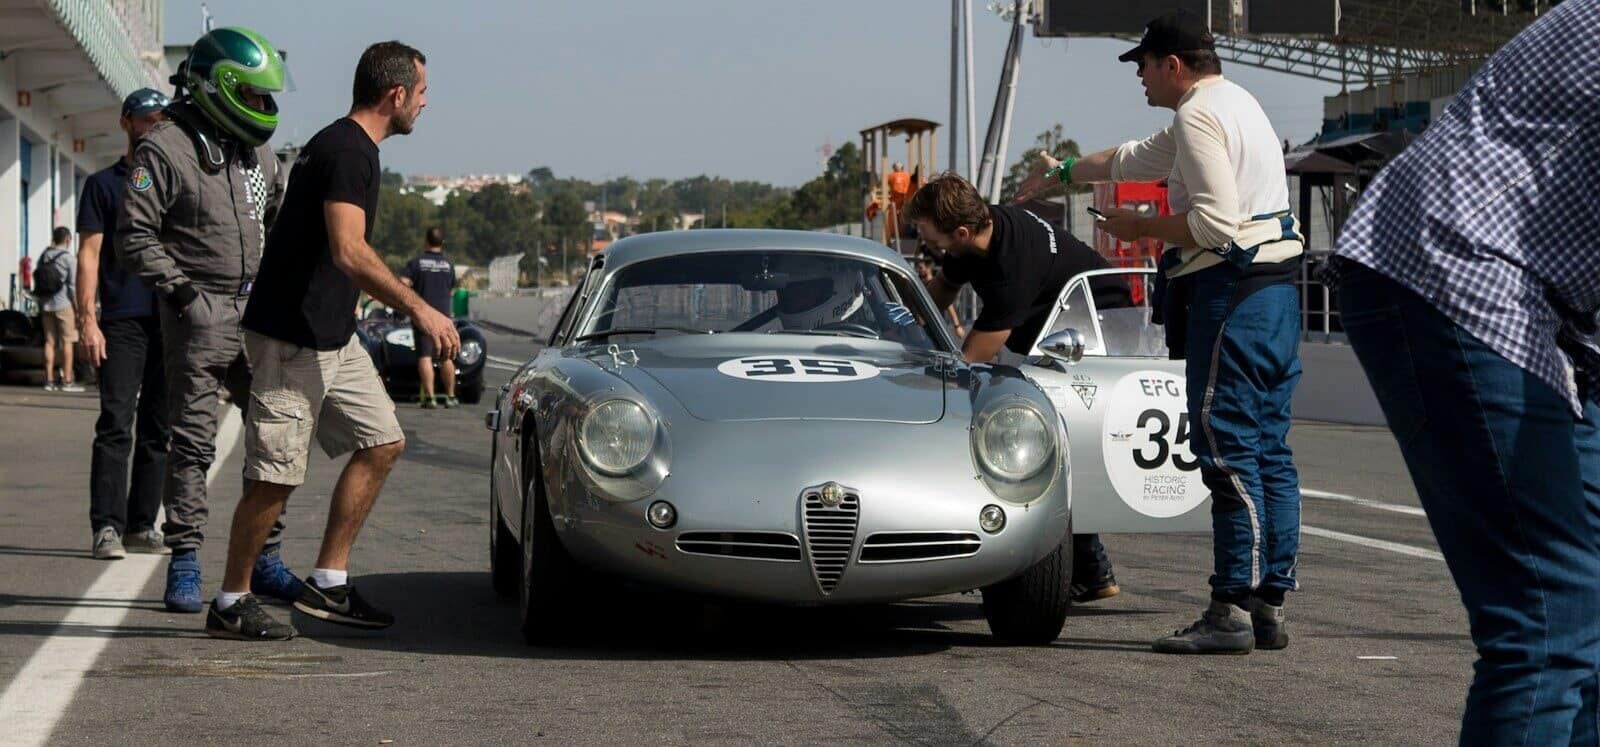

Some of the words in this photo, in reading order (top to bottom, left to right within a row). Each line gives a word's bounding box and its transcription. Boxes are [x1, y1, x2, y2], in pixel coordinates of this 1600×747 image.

[741, 359, 858, 376] 35
[1139, 379, 1180, 397] EFG
[1132, 408, 1201, 472] 35
[1144, 475, 1187, 484] HISTORIC
[1143, 484, 1186, 494] RACING
